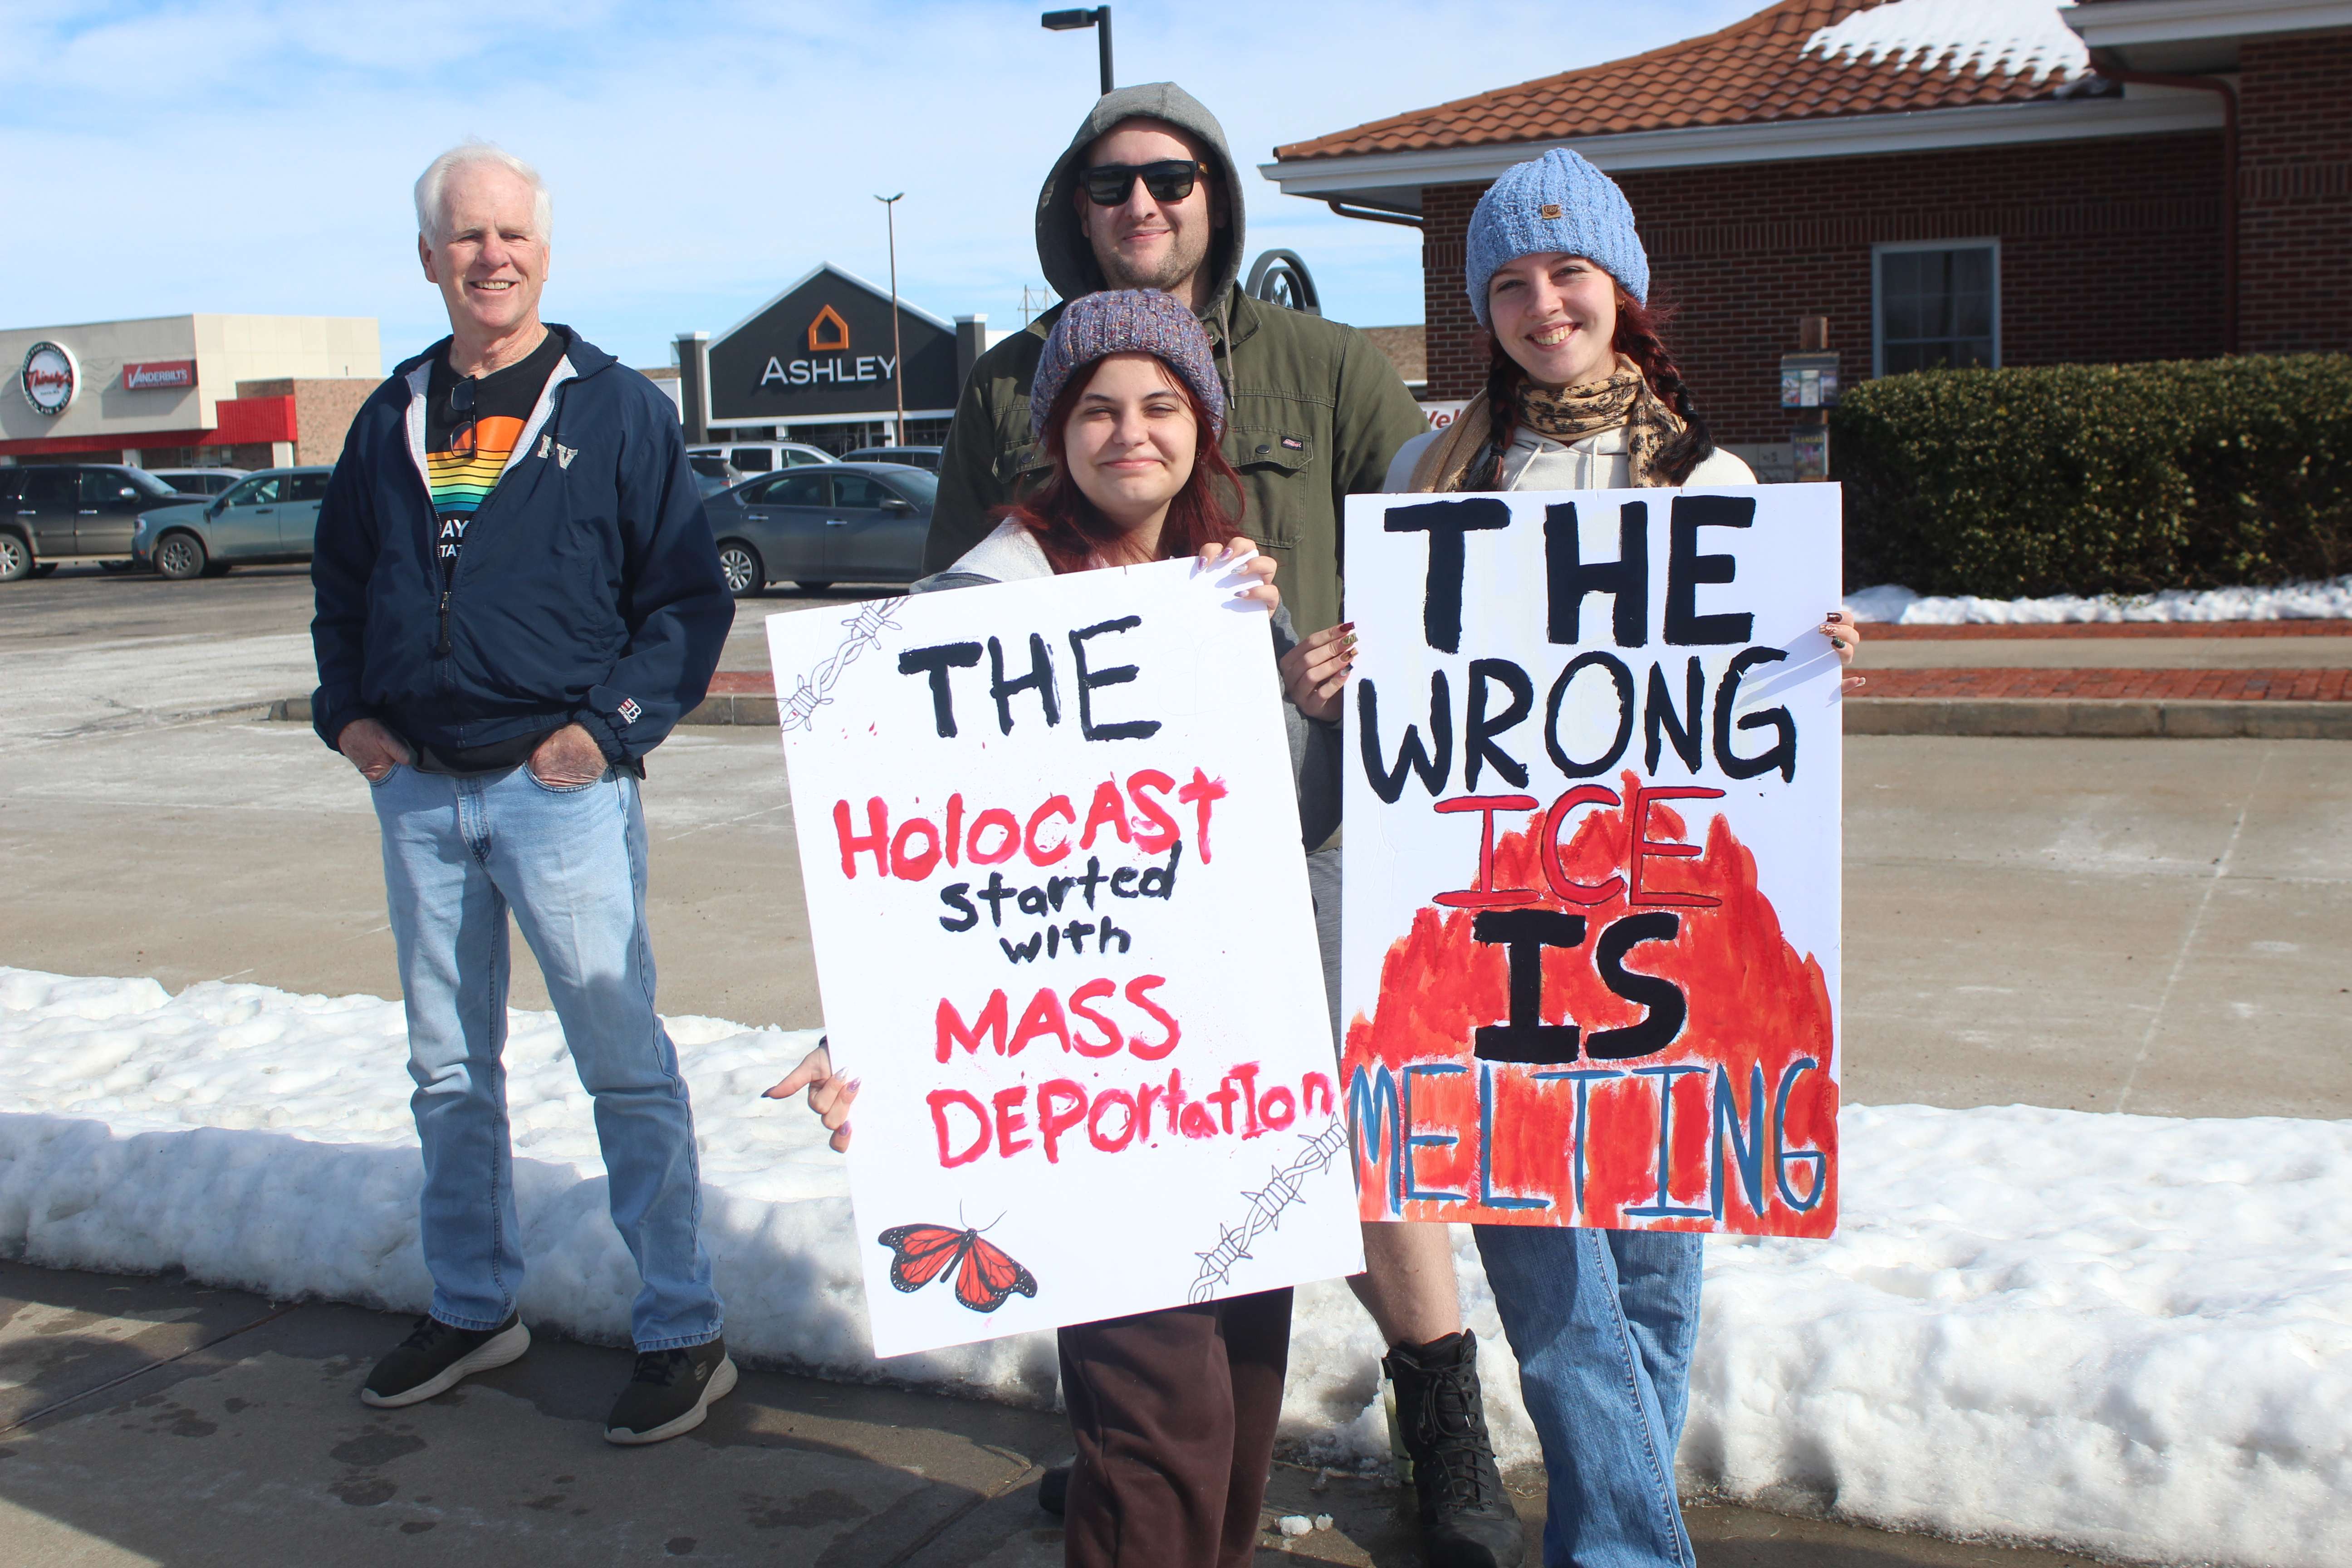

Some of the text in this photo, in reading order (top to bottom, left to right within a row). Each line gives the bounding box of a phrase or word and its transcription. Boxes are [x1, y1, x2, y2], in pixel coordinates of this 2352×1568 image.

[760, 355, 897, 385] ASHLEY
[1384, 496, 1757, 654] THE
[898, 615, 1162, 742] THE
[1358, 646, 1798, 804] WRONG
[939, 840, 1182, 933] started
[1432, 783, 1727, 907] ICE
[999, 916, 1132, 964] with
[1473, 908, 1688, 1065] IS
[935, 974, 1182, 1063] MASS
[1348, 1058, 1827, 1221] MELTING
